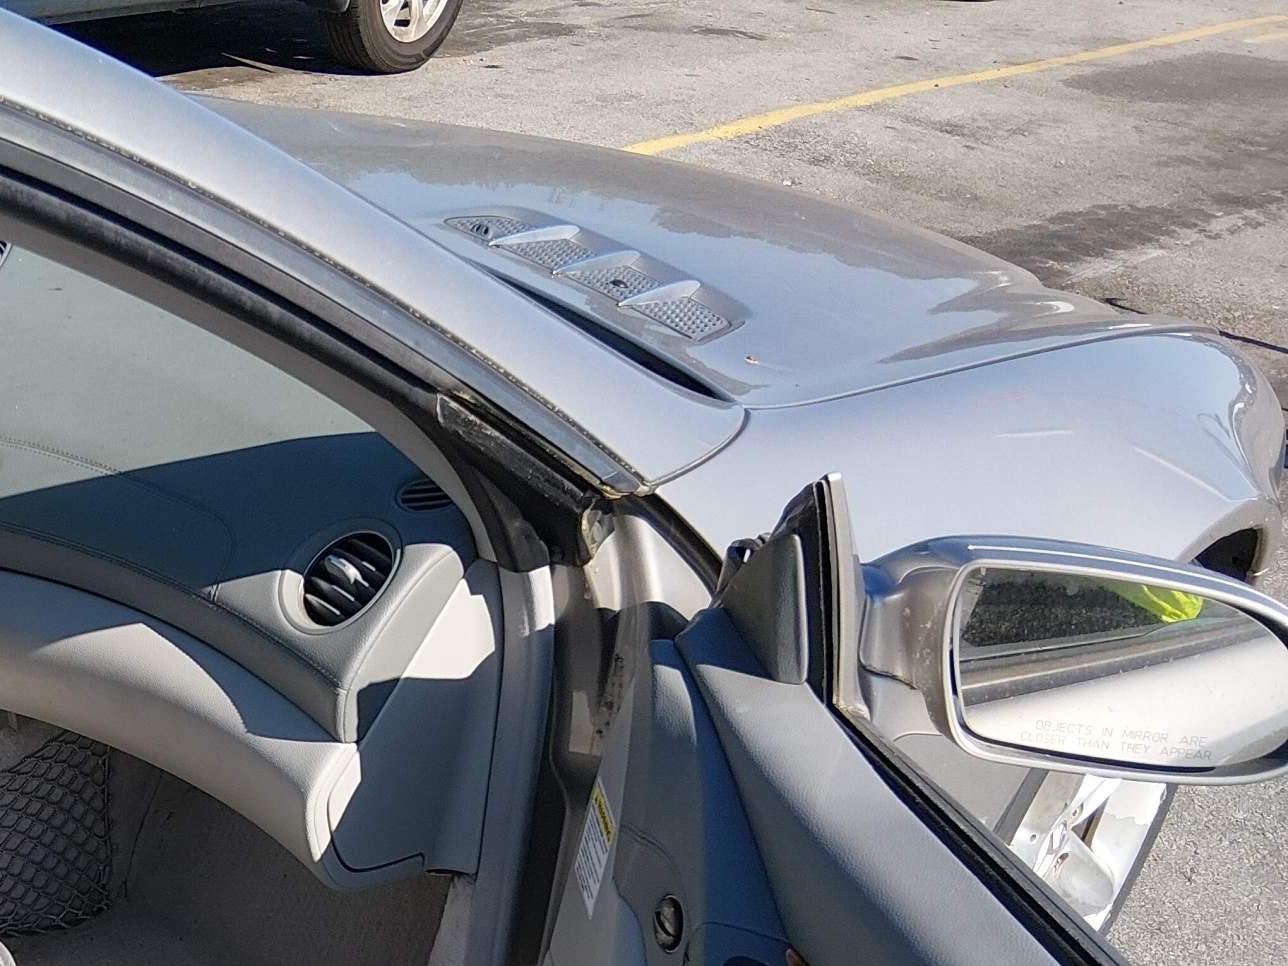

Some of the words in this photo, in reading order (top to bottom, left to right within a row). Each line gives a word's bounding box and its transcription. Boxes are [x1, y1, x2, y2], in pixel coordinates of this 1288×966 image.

[1020, 730, 1065, 746] CLOSER
[1077, 737, 1111, 750] THAN
[1120, 741, 1151, 755] THEY
[1160, 746, 1213, 761] APPEAR
[1035, 719, 1093, 736] OBJECTS
[1101, 727, 1114, 737] IN
[1121, 728, 1169, 744] MIRROR
[1179, 735, 1208, 747] ARE
